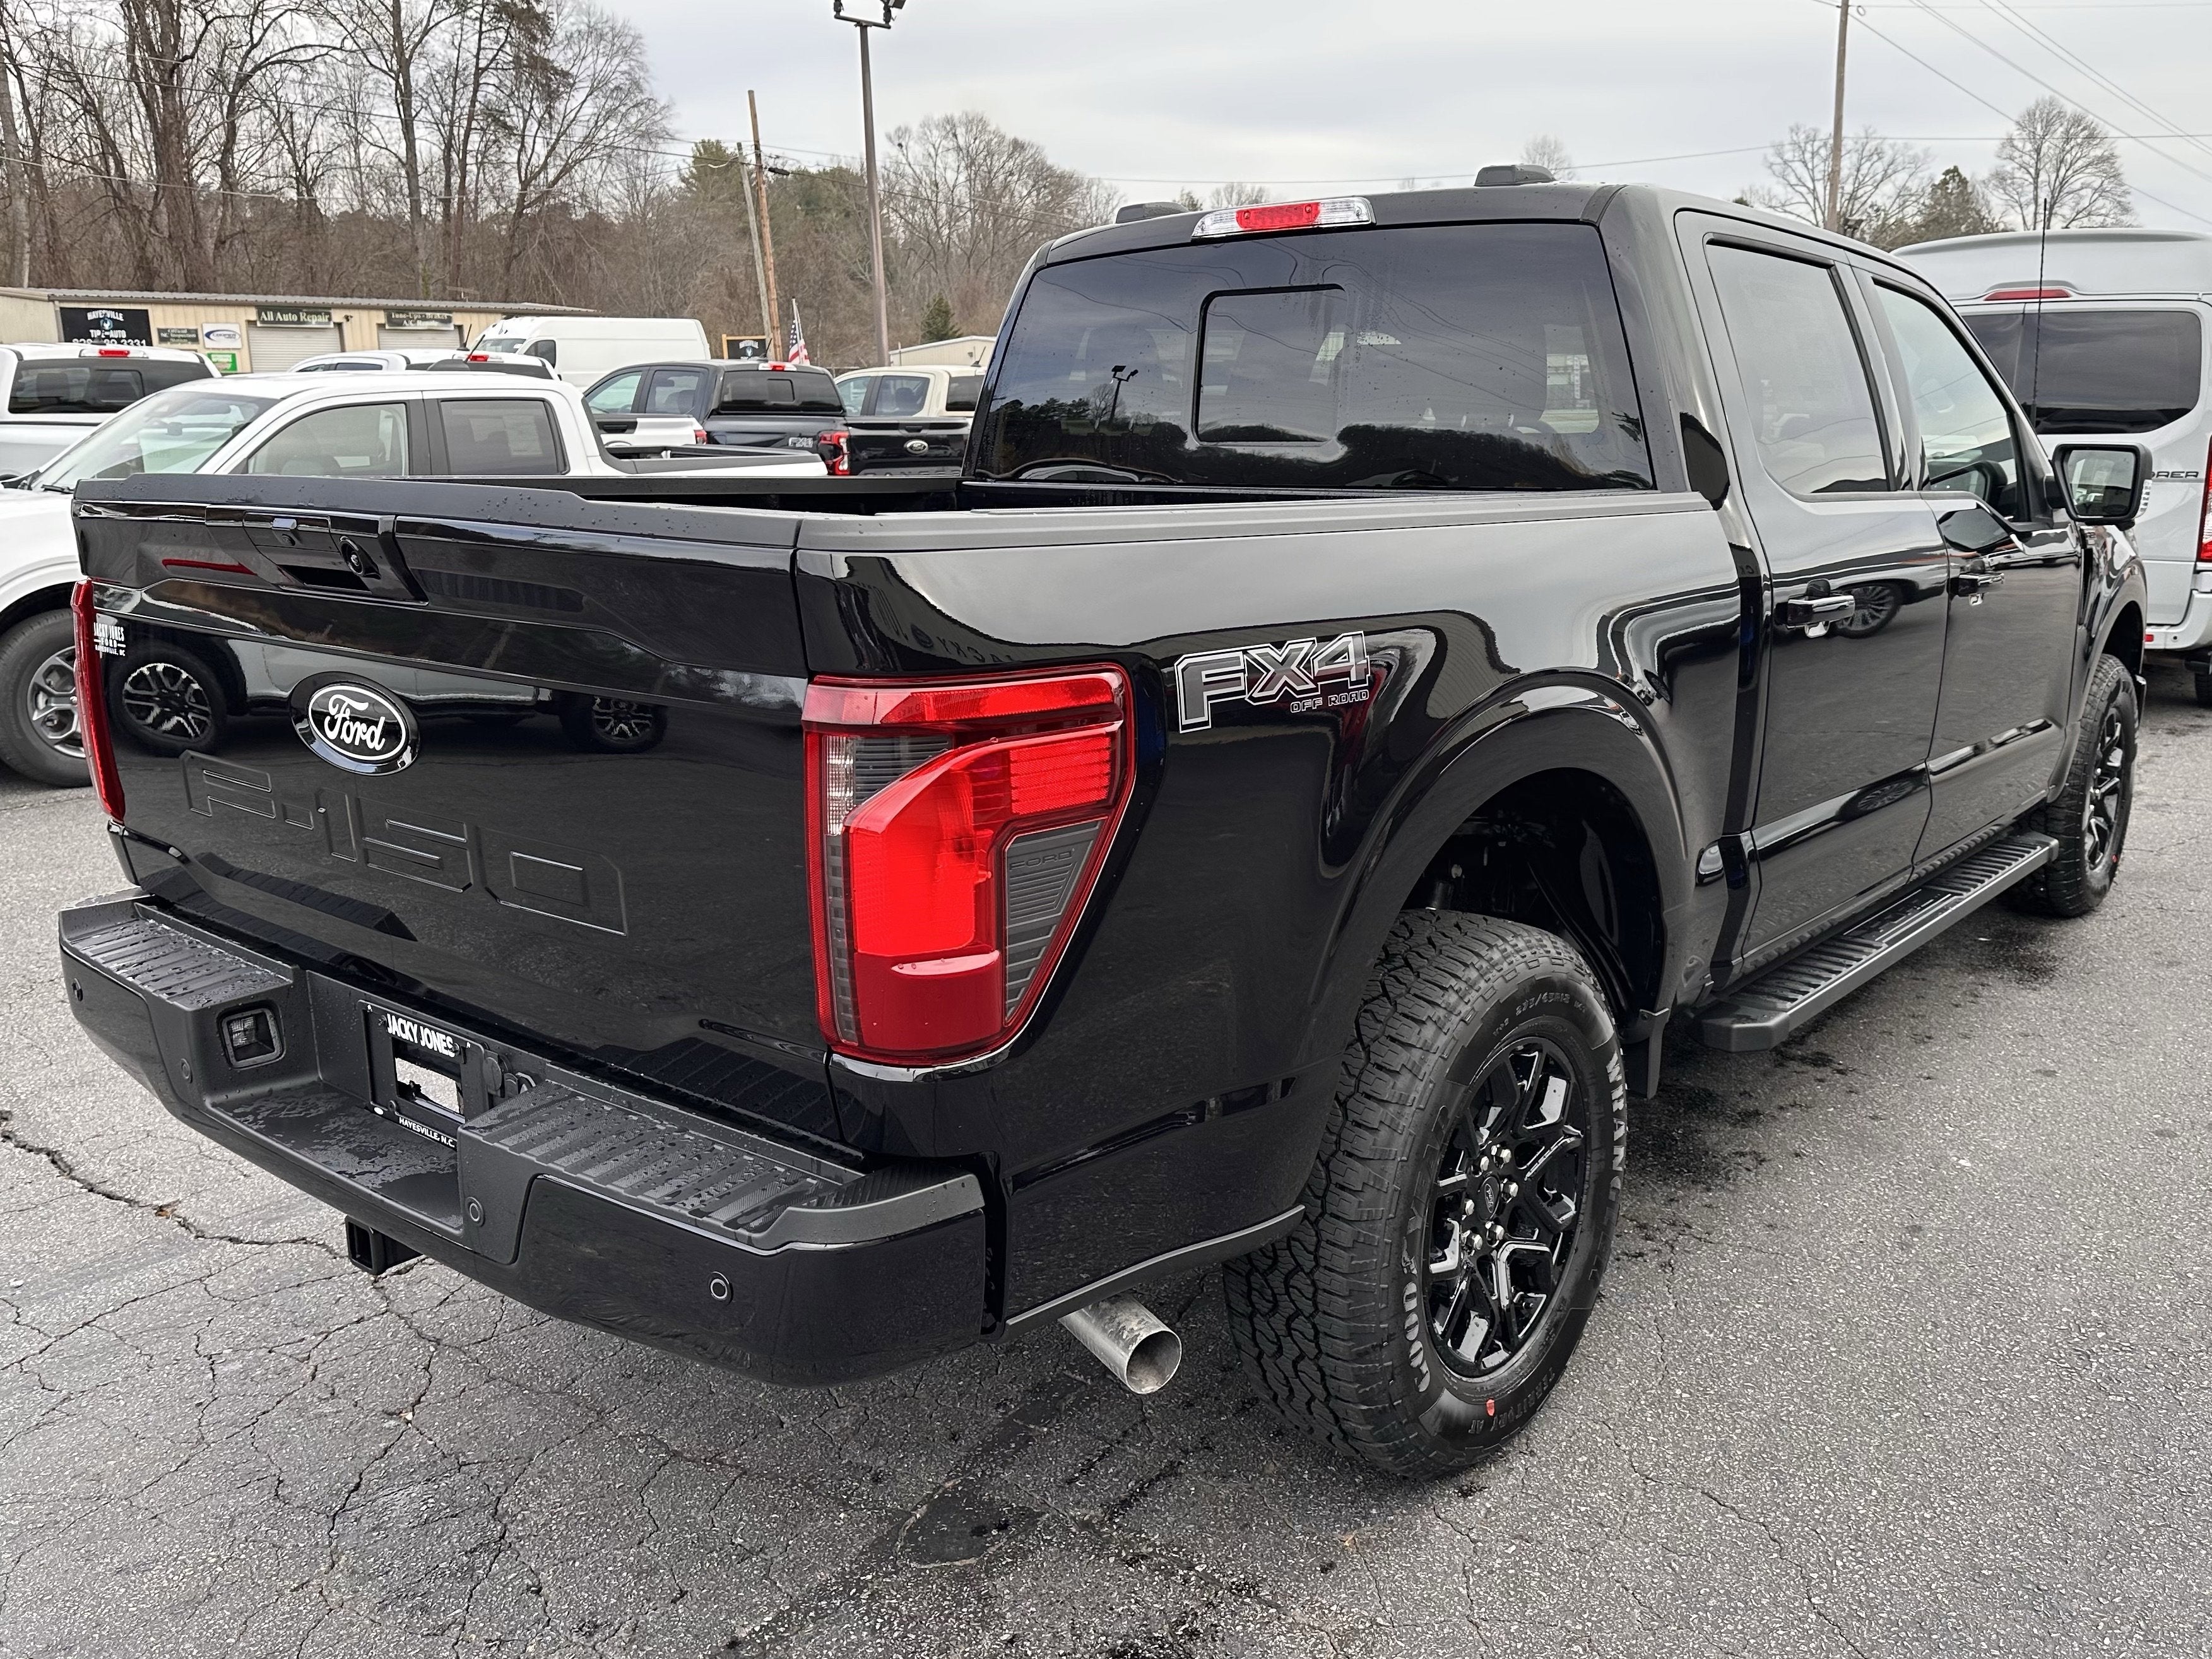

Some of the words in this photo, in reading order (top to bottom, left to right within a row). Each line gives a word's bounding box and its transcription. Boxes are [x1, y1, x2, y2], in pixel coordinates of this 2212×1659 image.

[260, 311, 274, 321] All
[276, 312, 298, 322] Auto
[299, 312, 330, 324] Repair
[101, 637, 117, 648] FORD
[109, 625, 124, 642] JONES
[1174, 630, 1371, 734] FX4
[1290, 697, 1323, 713] OFF
[1328, 689, 1369, 707] ROAD
[324, 694, 386, 751] Ford
[182, 749, 628, 937] F-150
[1010, 850, 1072, 871] FORD
[387, 1013, 418, 1044] JACKY
[420, 1025, 455, 1058] JONES
[441, 1135, 455, 1148] N.C.
